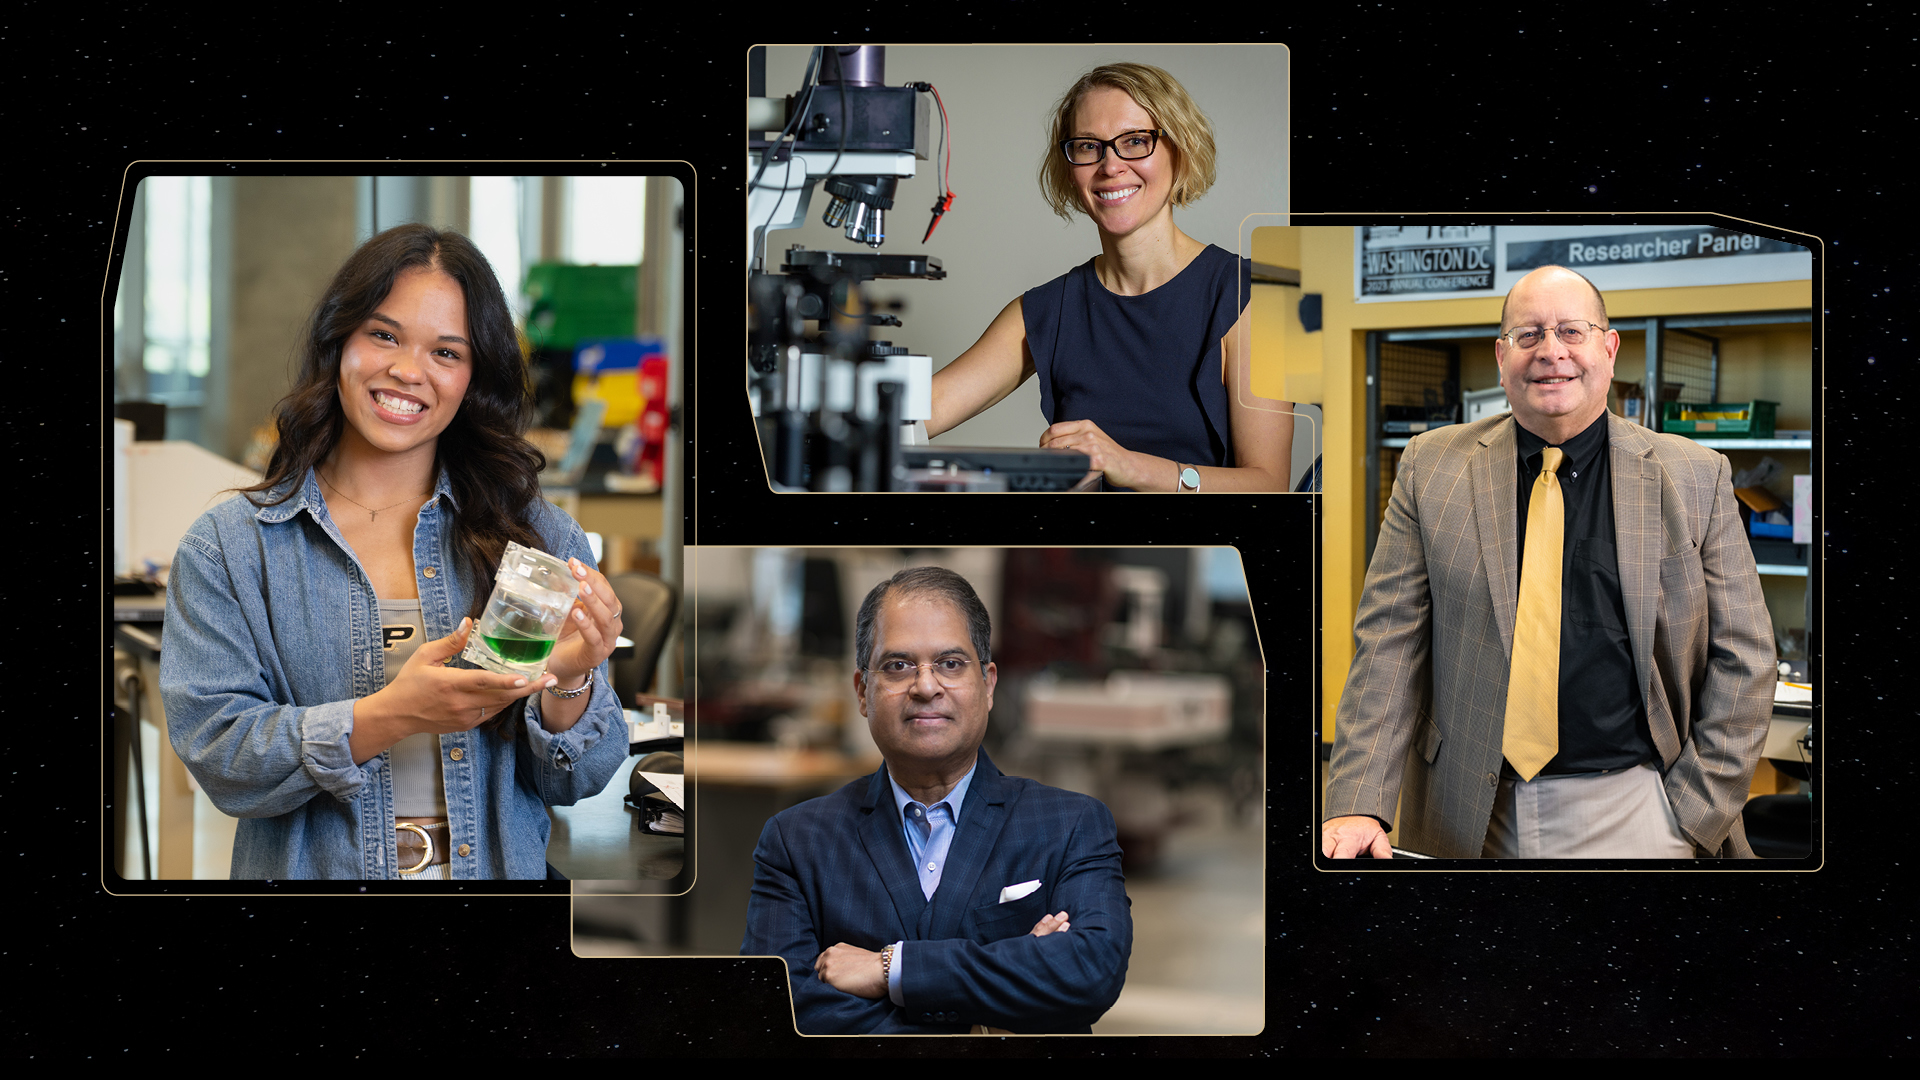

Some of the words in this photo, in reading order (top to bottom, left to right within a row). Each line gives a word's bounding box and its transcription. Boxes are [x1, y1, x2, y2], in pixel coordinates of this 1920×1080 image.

[1367, 248, 1464, 275] WASHINGTON
[1467, 246, 1490, 270] DC
[1569, 237, 1691, 263] Researcher
[1698, 233, 1760, 254] Panel
[1366, 280, 1388, 292] 2023
[1389, 278, 1424, 291] ANNUAL
[1425, 275, 1489, 290] CONFERENCE
[382, 624, 416, 651] P
